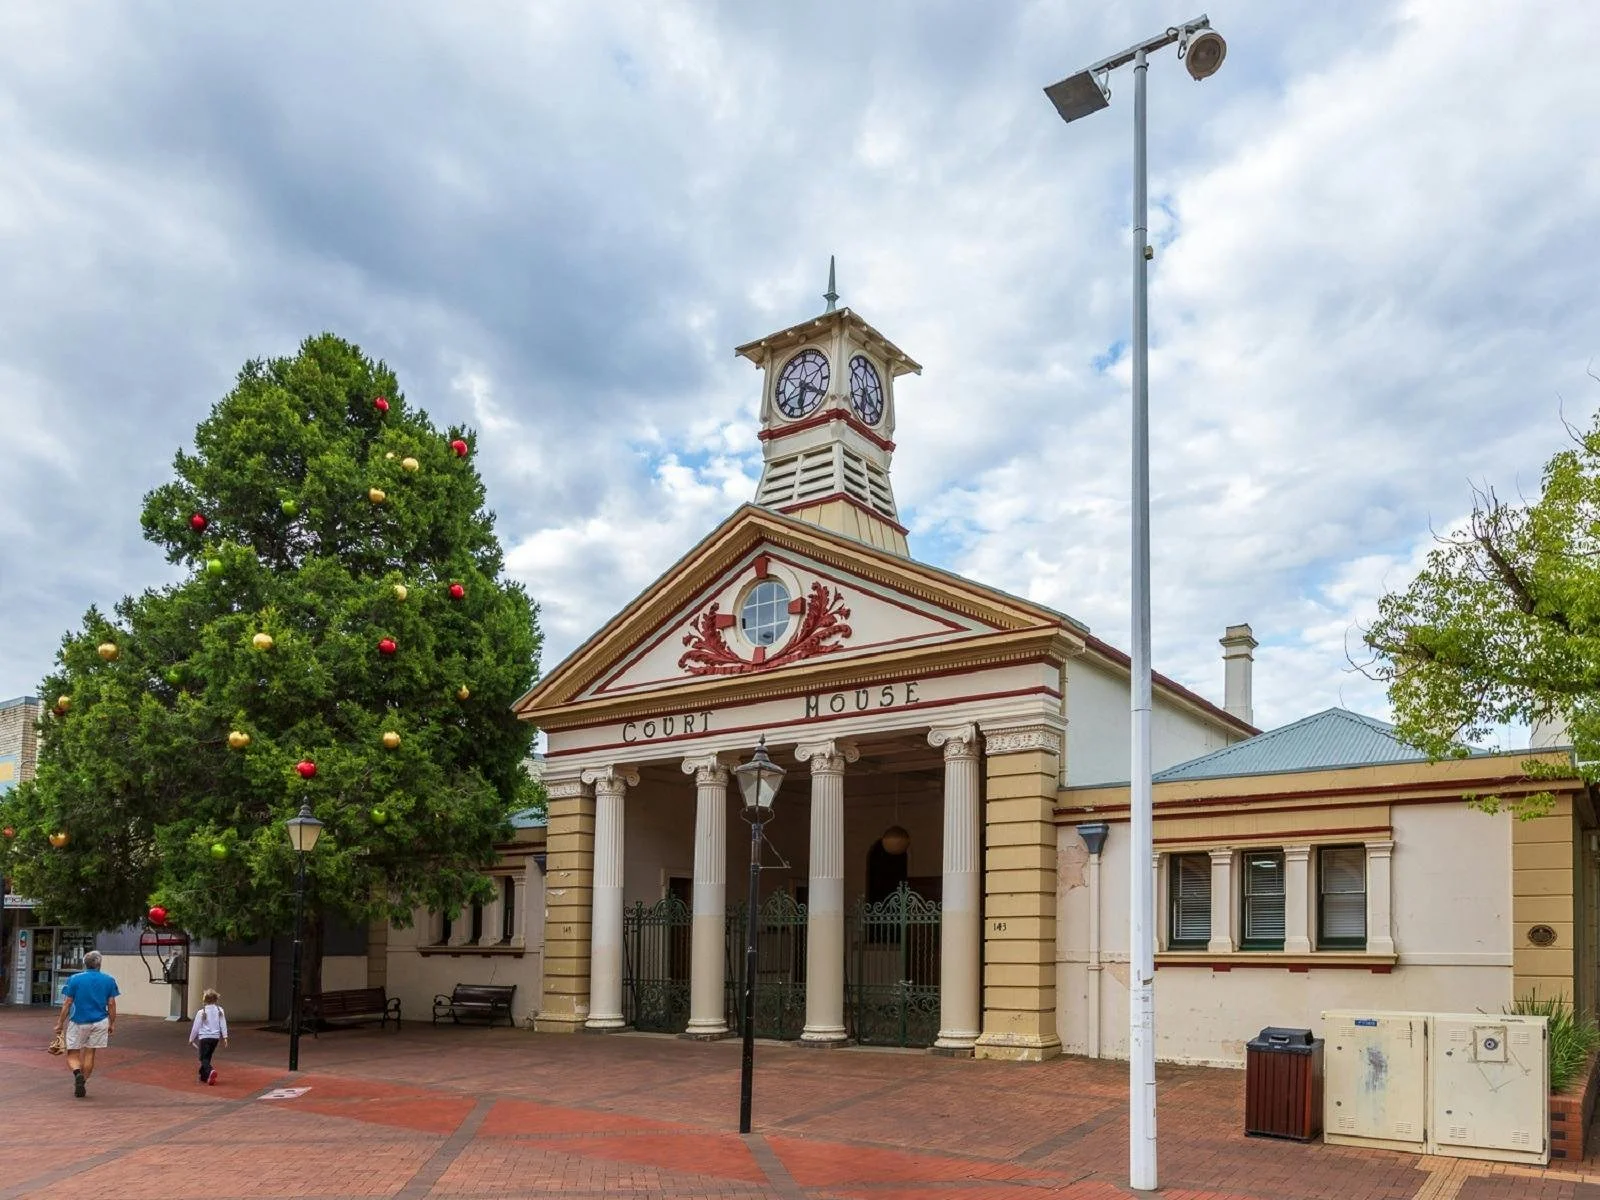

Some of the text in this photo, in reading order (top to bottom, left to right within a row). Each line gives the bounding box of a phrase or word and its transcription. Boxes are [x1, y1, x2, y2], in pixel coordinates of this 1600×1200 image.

[622, 682, 920, 743] COURT HOUSE
[993, 922, 1007, 931] 143
